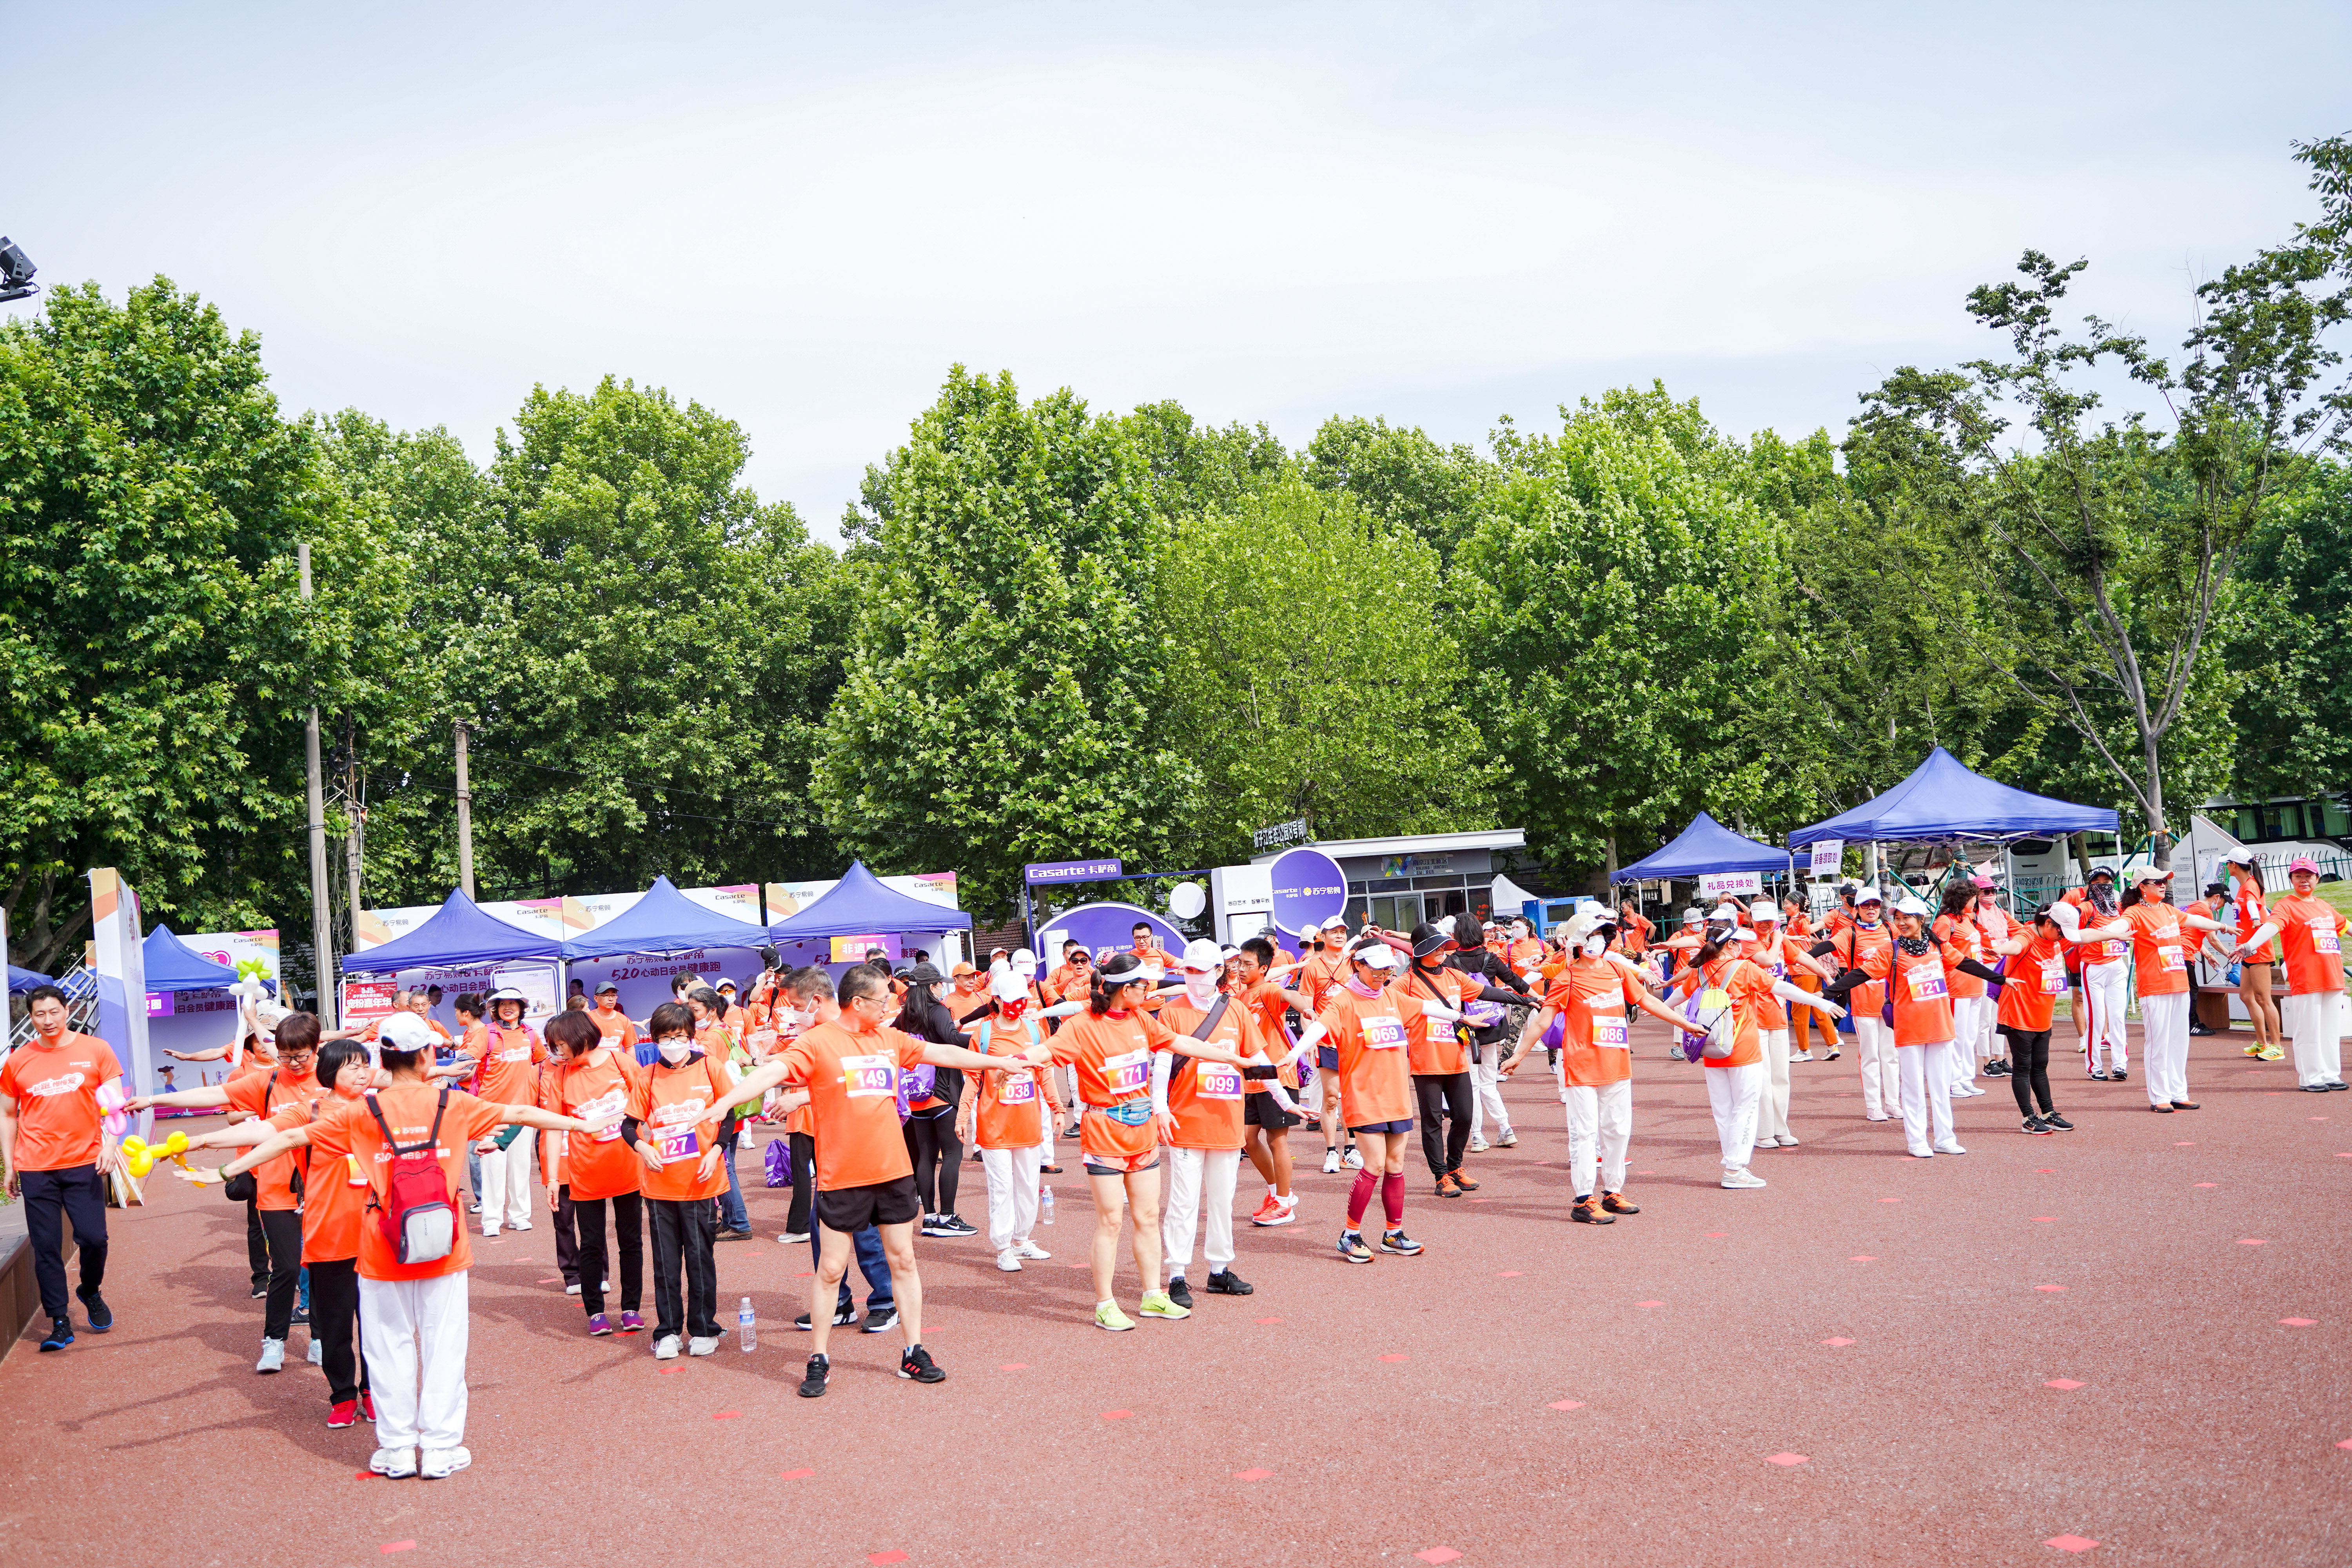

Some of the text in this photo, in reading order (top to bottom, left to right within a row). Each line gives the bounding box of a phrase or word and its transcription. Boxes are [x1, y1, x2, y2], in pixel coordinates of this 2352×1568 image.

[1814, 852, 1837, 864] 装备领取处
[1029, 864, 1117, 878] Casarte 卡萨帝
[1313, 886, 1341, 895] 苏宁易购
[1708, 878, 1753, 890] 礼品兑换处
[383, 918, 409, 927] 苏宁易购
[2108, 942, 2124, 952] 129
[2320, 938, 2338, 948] 095
[2167, 954, 2184, 965] 146
[1917, 980, 1940, 995] 121
[2046, 978, 2063, 991] 019
[1372, 1026, 1399, 1042] 069
[1433, 1024, 1455, 1037] 054
[1600, 1027, 1623, 1041] 086
[855, 1069, 886, 1087] 149
[1117, 1065, 1142, 1085] 171
[1006, 1083, 1030, 1098] 038
[1205, 1076, 1235, 1092] 099
[660, 1136, 688, 1156] 127
